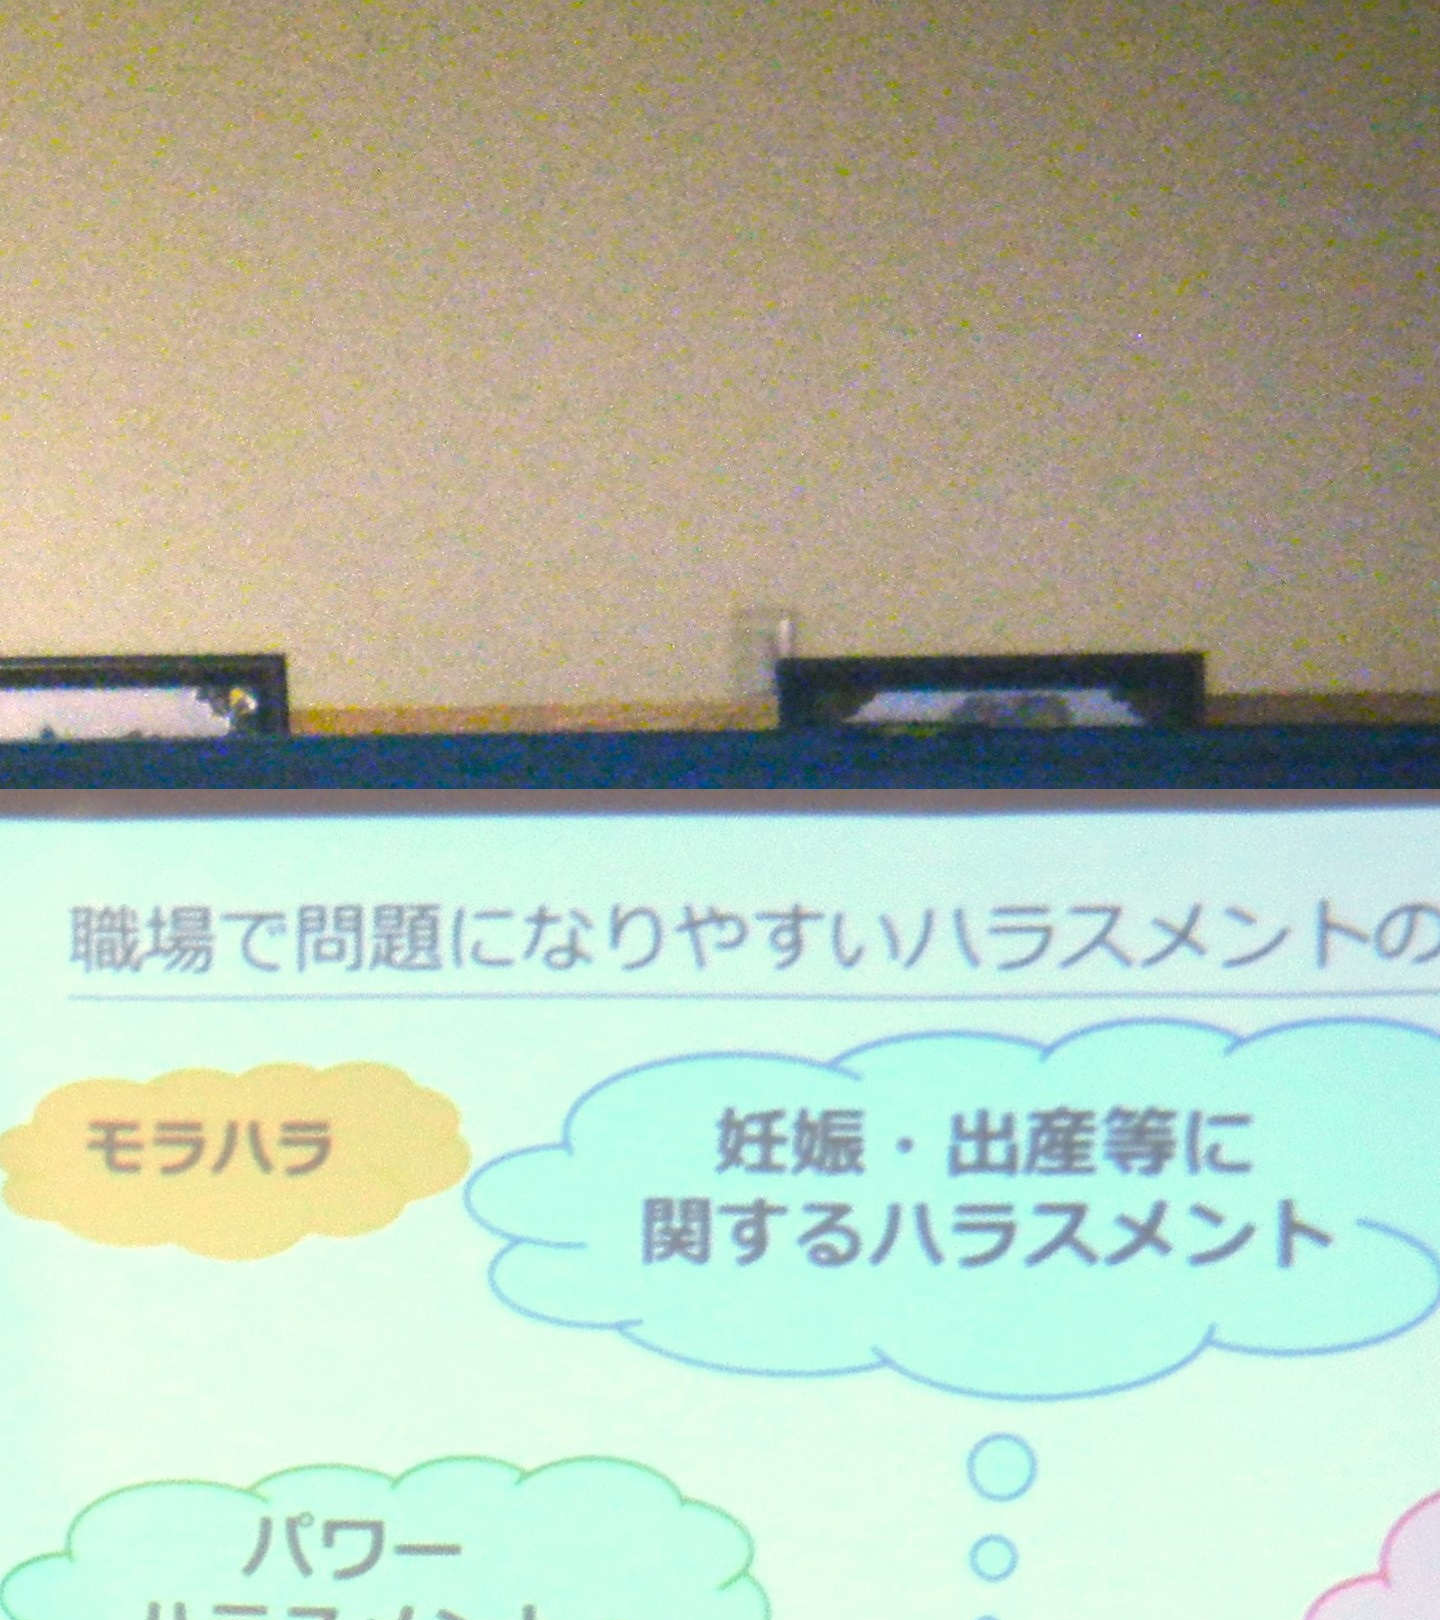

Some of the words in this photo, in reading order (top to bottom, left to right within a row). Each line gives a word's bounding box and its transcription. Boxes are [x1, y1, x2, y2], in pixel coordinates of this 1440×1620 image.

[68, 897, 1440, 977] 職場で問題になりやすいハラスメントの
[86, 1117, 335, 1178] モラハラ
[718, 1107, 1254, 1180] 妊娠・出産等に
[644, 1198, 1333, 1272] 関するハラスメント
[244, 1510, 463, 1582] パワー
